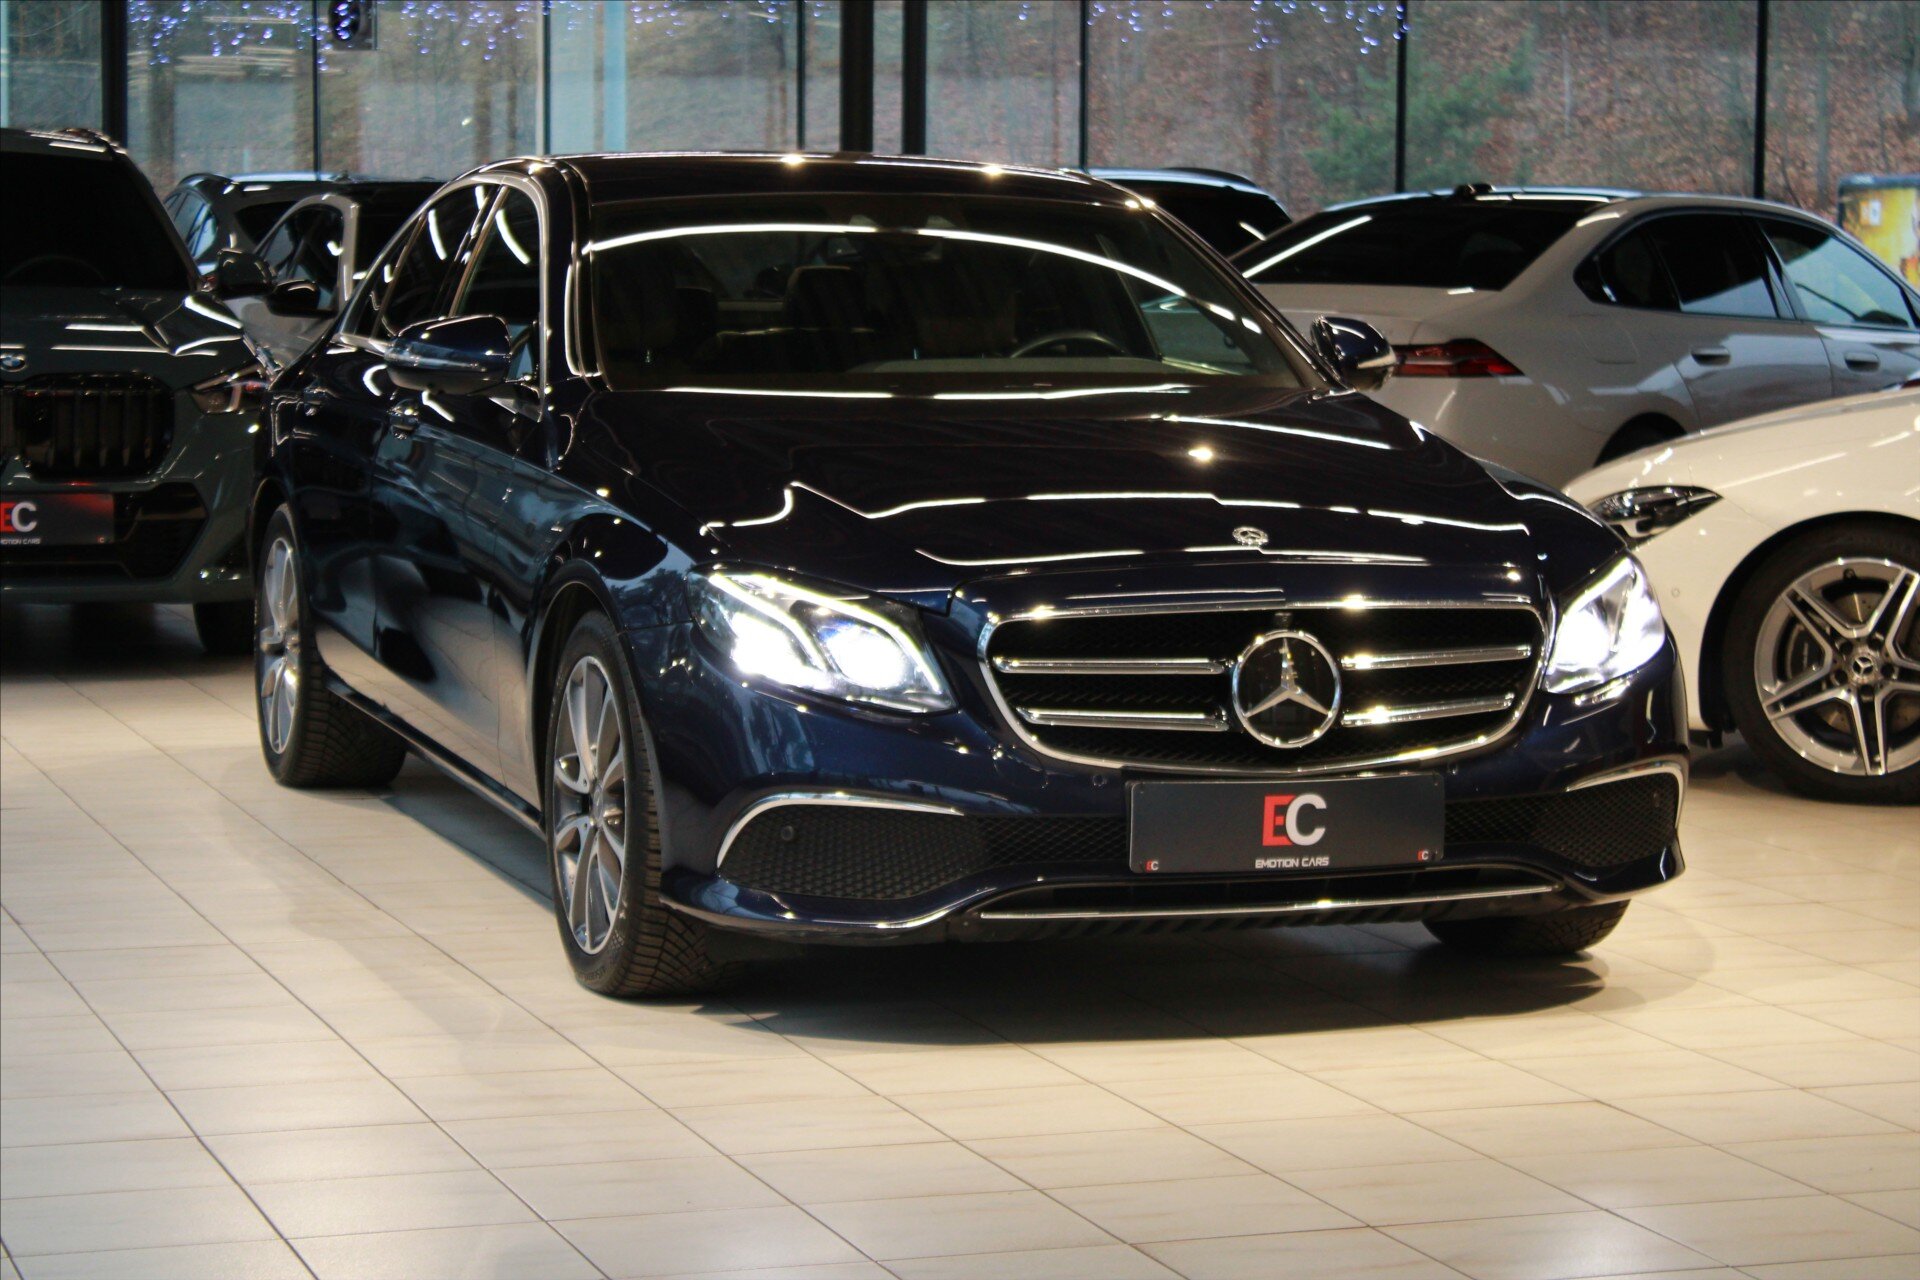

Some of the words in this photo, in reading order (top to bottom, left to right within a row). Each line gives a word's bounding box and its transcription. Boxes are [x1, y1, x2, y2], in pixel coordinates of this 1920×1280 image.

[0, 501, 37, 532] EC
[23, 537, 41, 545] CARS
[1262, 793, 1327, 846] EC
[1255, 858, 1299, 869] EMOTION
[1301, 856, 1330, 868] CARS
